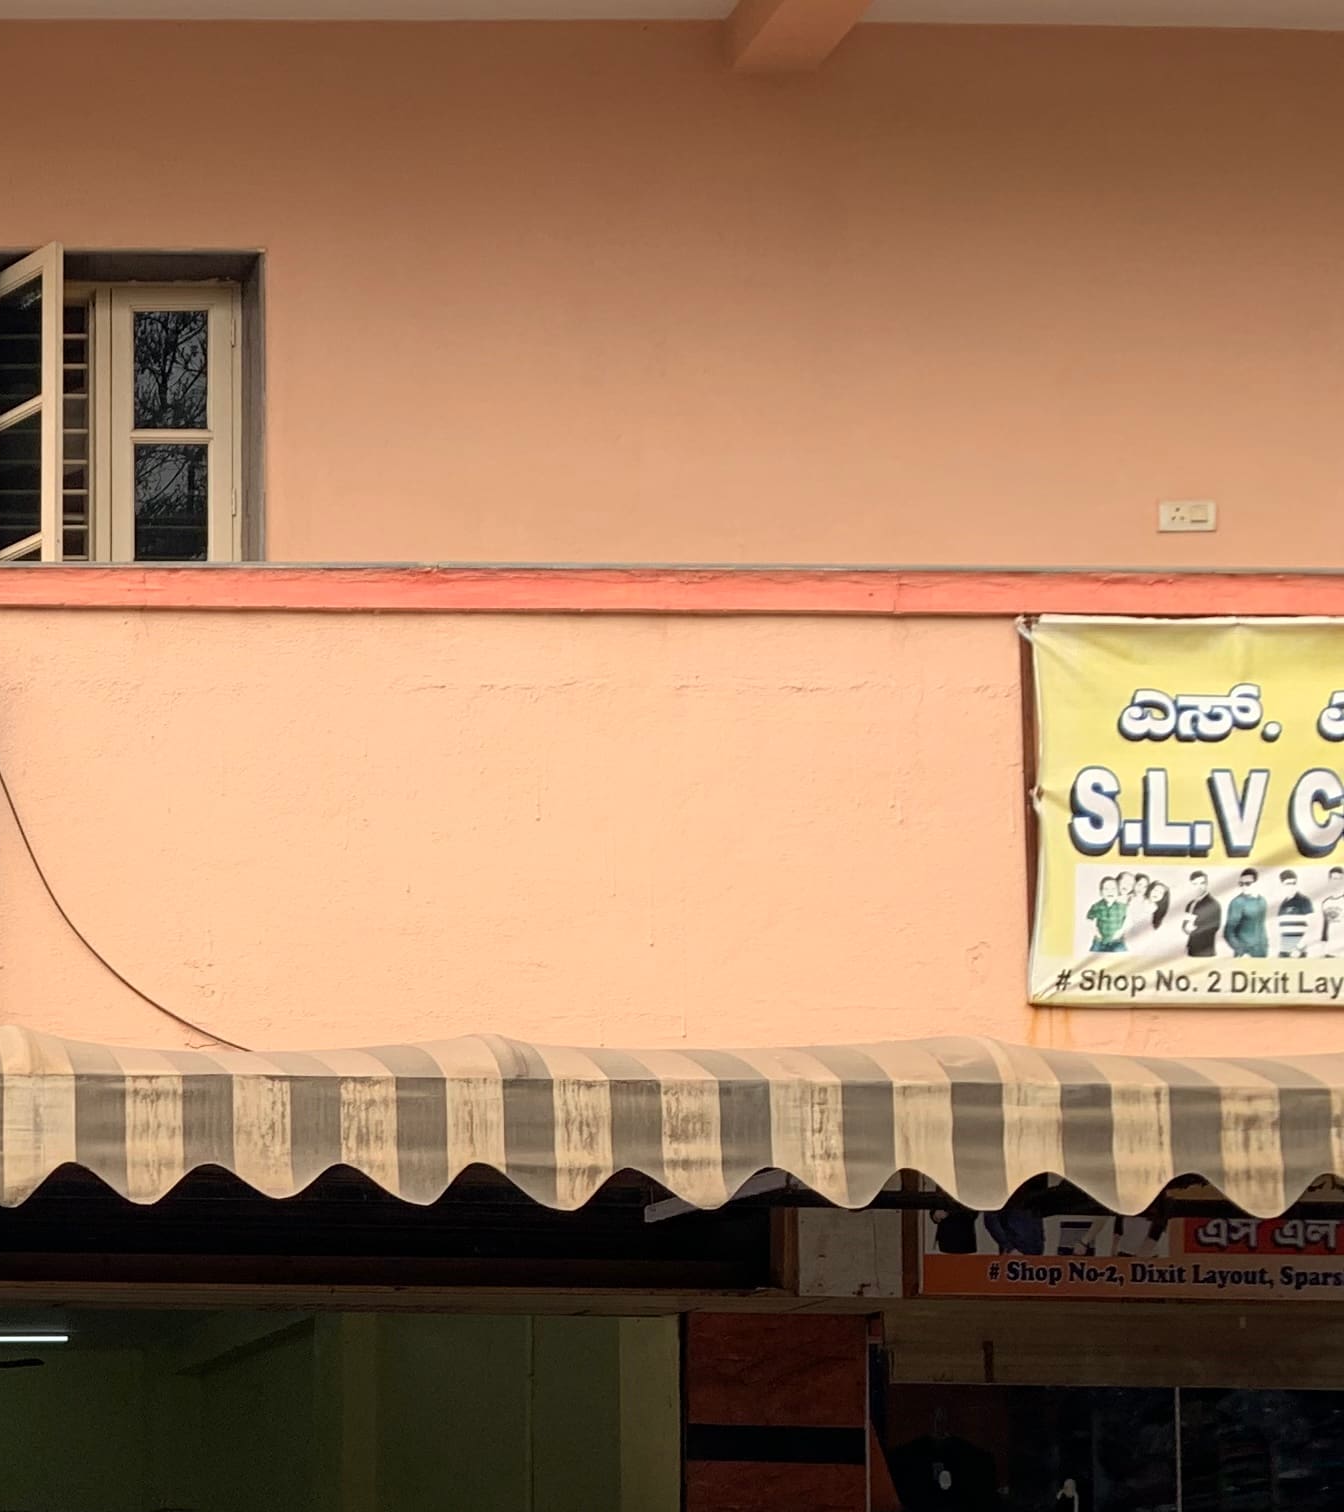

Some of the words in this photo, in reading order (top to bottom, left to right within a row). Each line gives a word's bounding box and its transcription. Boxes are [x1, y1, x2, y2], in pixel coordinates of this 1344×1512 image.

[1069, 765, 1270, 857] S.L.V
[1079, 969, 1146, 997] Shop
[1155, 970, 1198, 993] No.
[1230, 971, 1290, 995] Dixit
[1006, 1261, 1062, 1286] Shop
[1130, 1264, 1186, 1285] Dixit
[1192, 1265, 1274, 1289] Layout,
